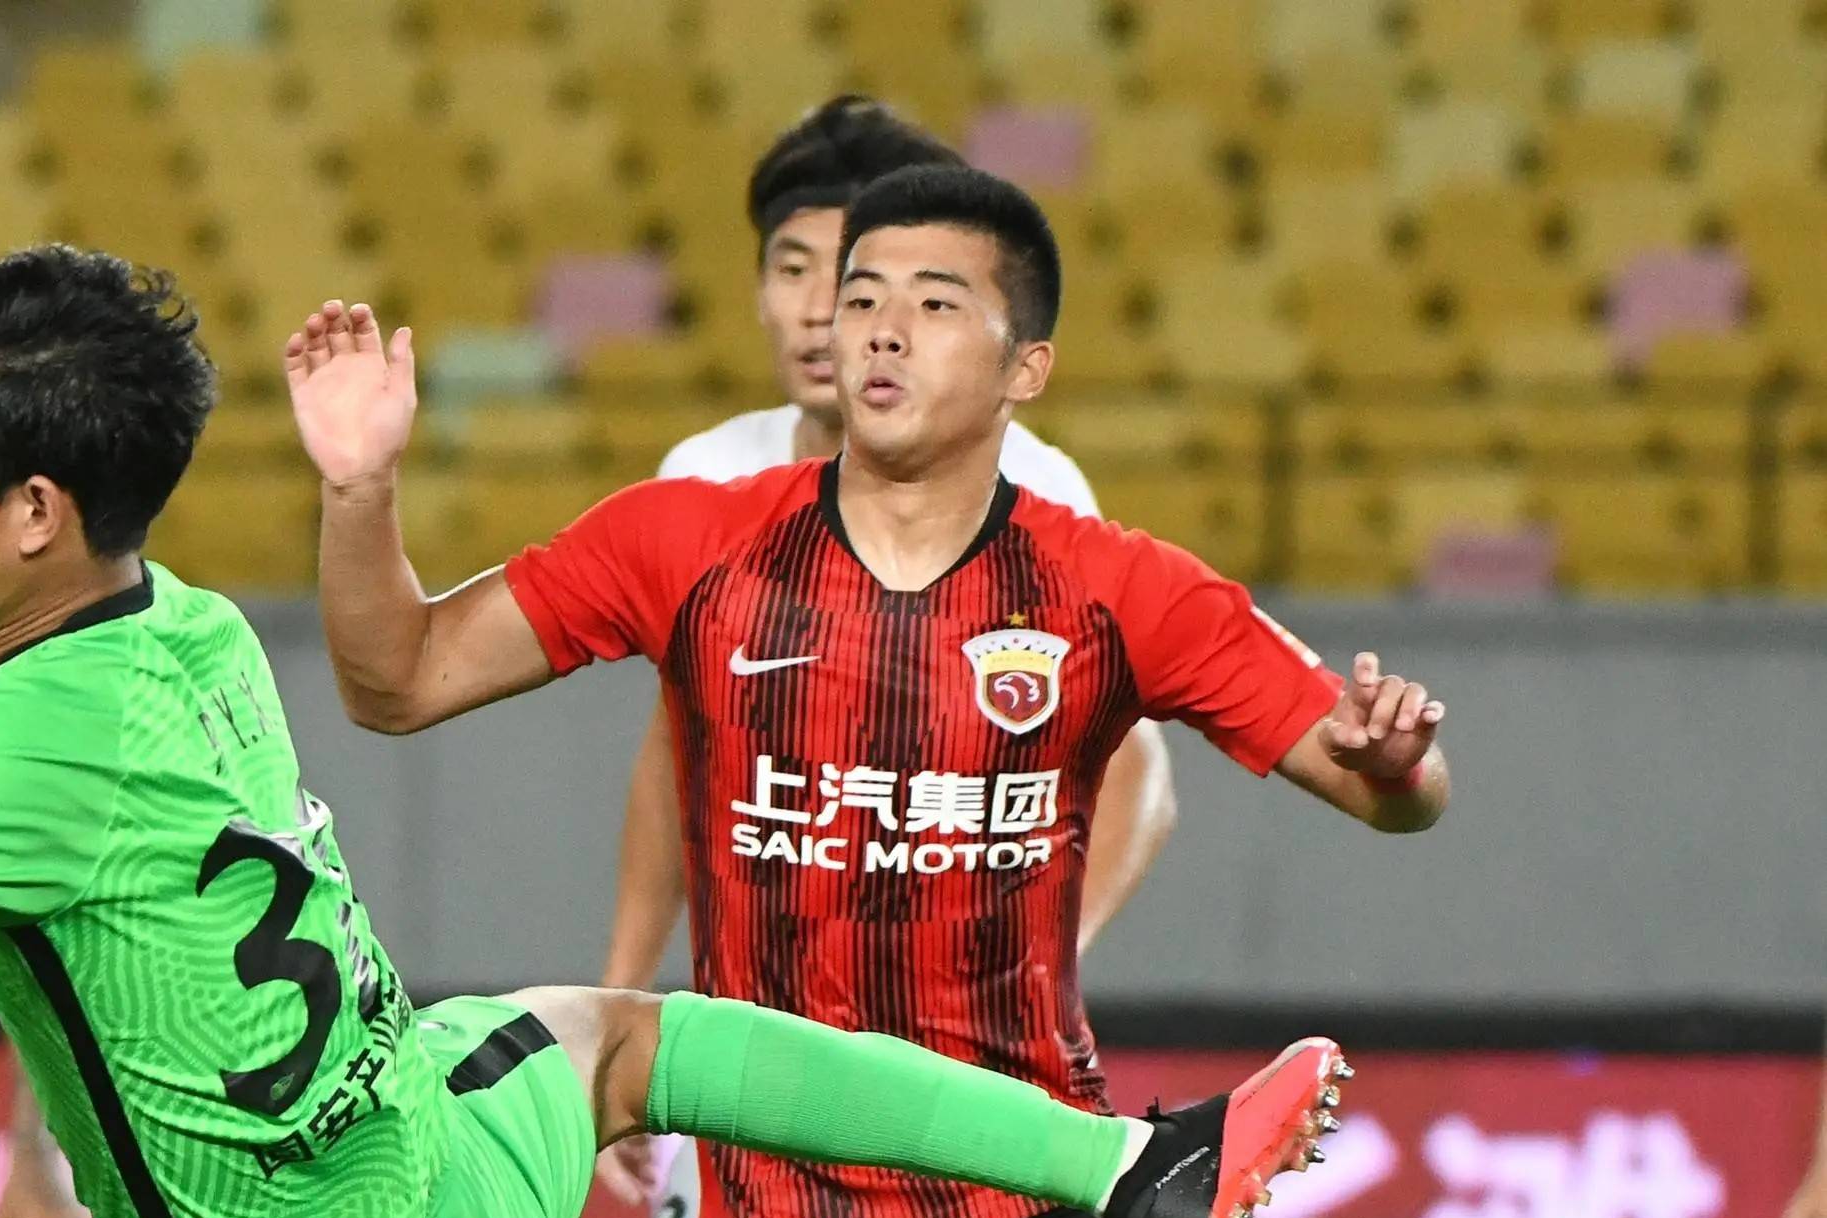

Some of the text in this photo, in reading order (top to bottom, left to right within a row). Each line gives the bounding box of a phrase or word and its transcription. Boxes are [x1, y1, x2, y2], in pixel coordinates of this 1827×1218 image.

[730, 754, 1061, 834] 上汽集团
[731, 823, 1053, 874] SAIC MOTOR
